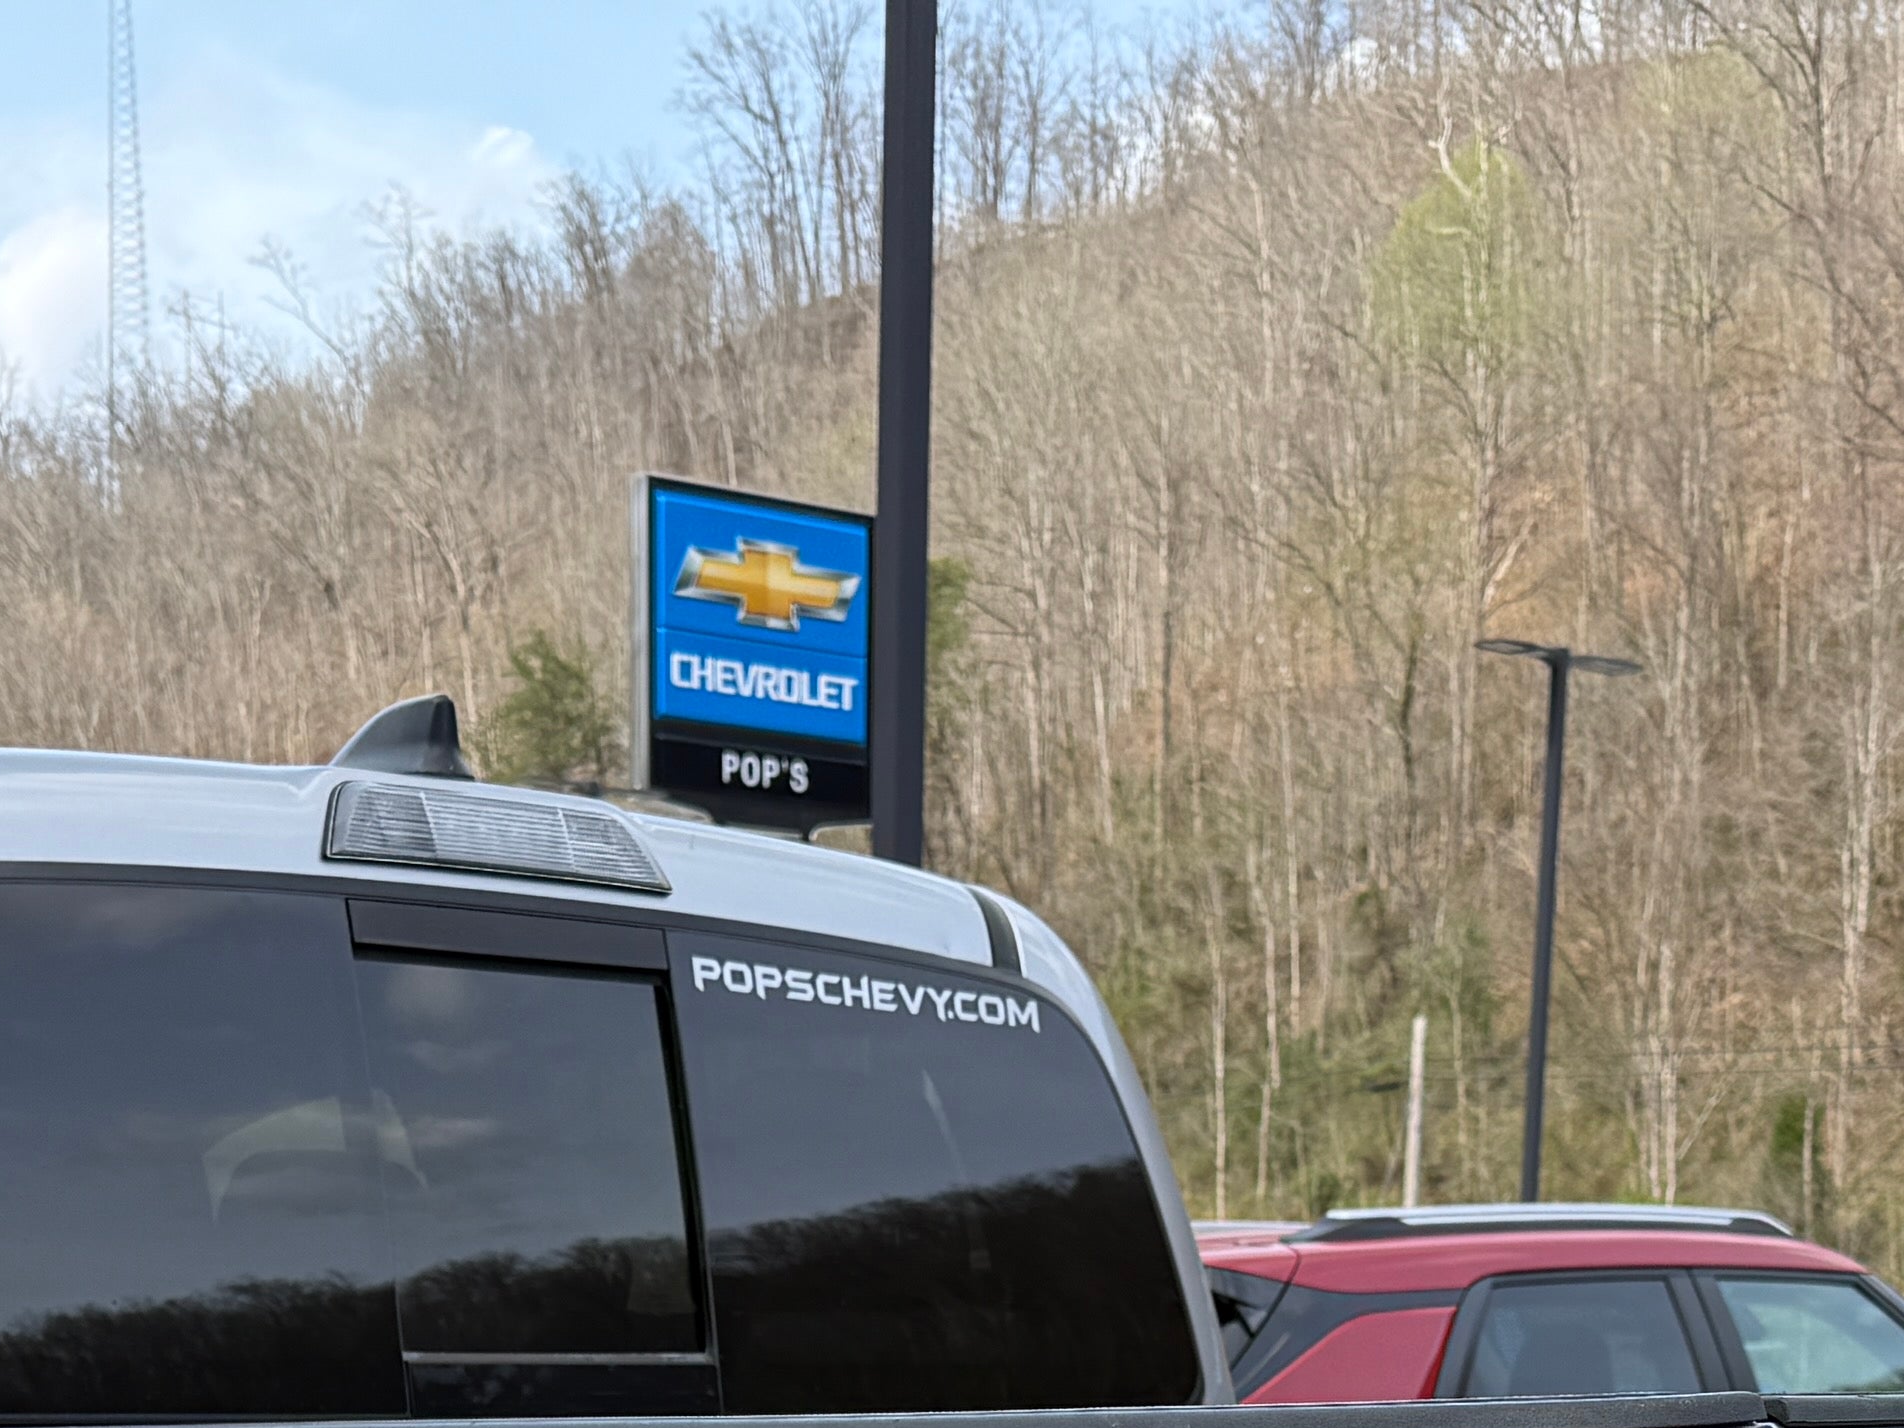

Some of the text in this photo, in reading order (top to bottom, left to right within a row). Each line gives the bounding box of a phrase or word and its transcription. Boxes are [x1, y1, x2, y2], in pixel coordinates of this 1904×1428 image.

[669, 651, 859, 712] CHEVROLET
[720, 748, 810, 794] POP'S
[690, 953, 1041, 1034] POPSCHEVY.COM
